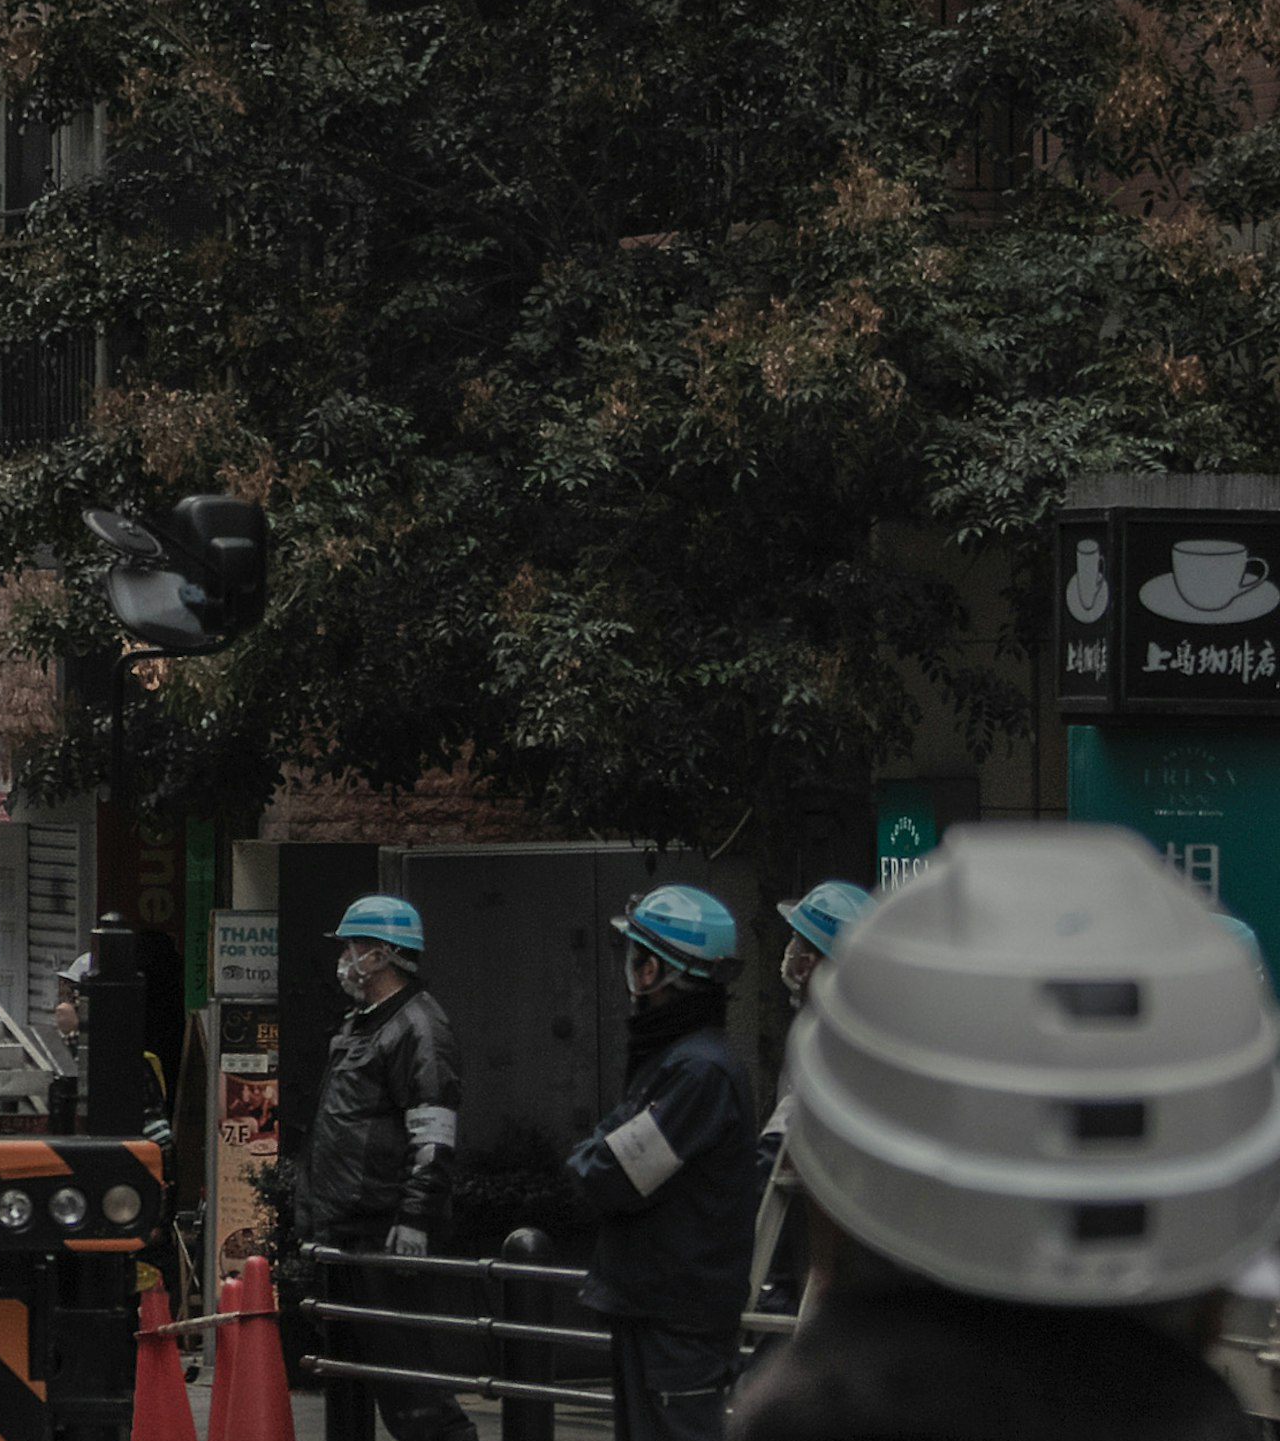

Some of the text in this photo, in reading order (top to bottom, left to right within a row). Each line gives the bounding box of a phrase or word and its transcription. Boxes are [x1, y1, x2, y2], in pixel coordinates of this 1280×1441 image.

[1141, 638, 1277, 685] 上島珈琲店
[219, 945, 246, 957] FOR
